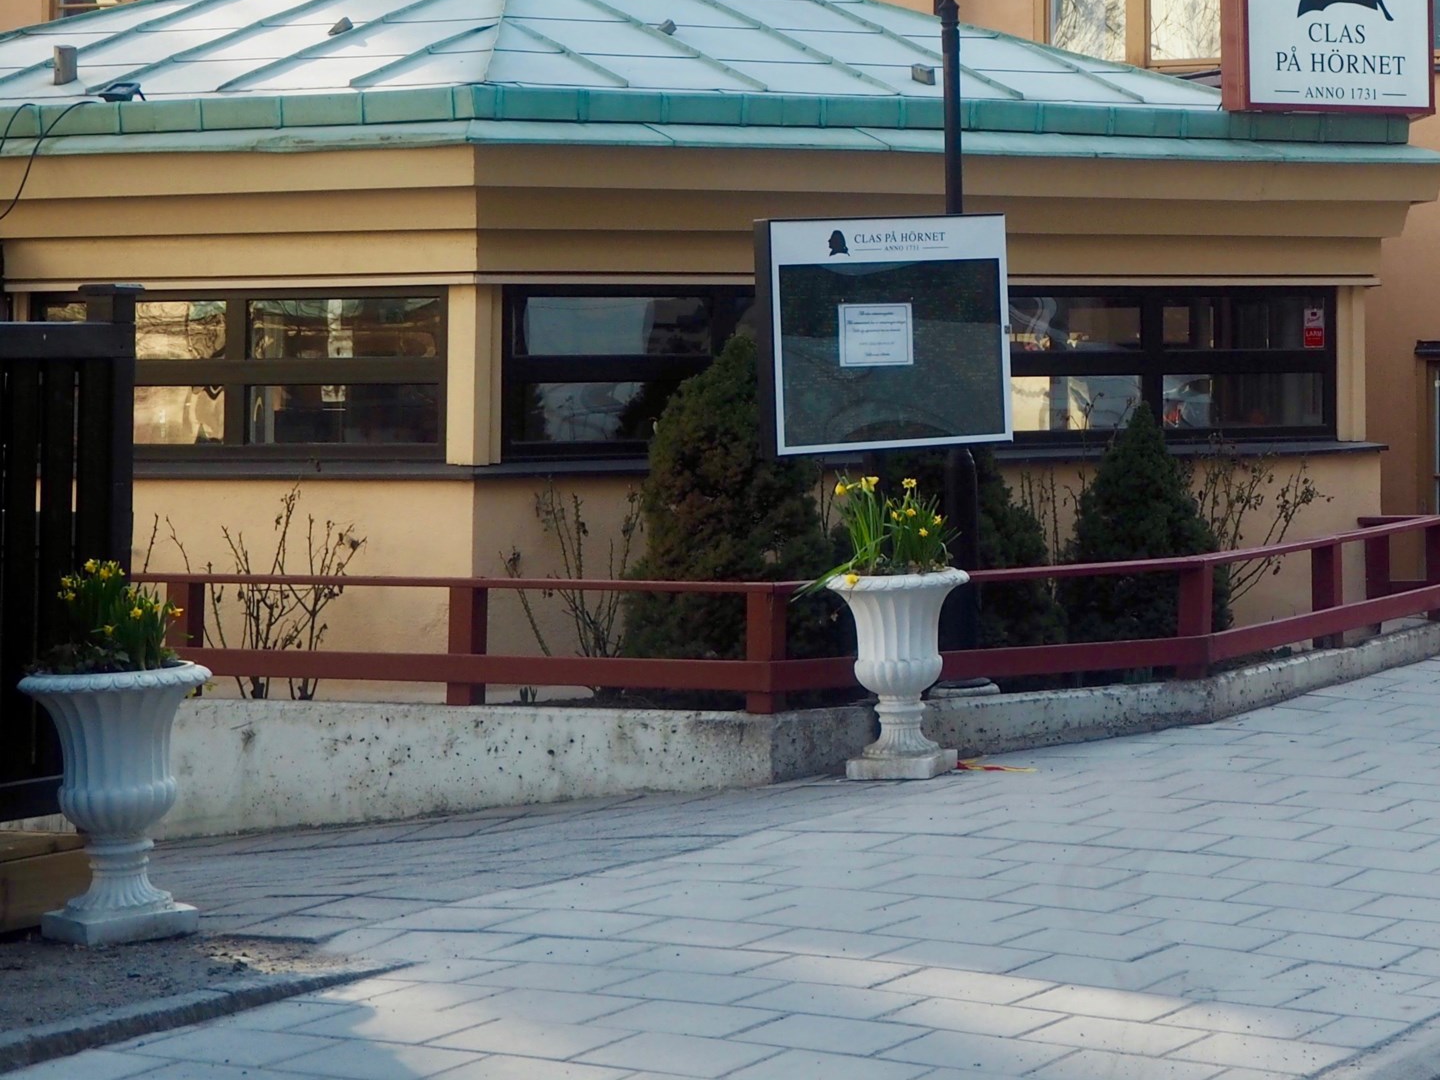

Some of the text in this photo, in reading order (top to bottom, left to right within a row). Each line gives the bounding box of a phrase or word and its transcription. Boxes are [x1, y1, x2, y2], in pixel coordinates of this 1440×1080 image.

[1308, 22, 1366, 44] CLAS
[1275, 46, 1406, 76] PÅ HÖRNET
[1305, 86, 1377, 101] ANNO 1731
[854, 230, 946, 244] CLAS PÅ HÖRNET
